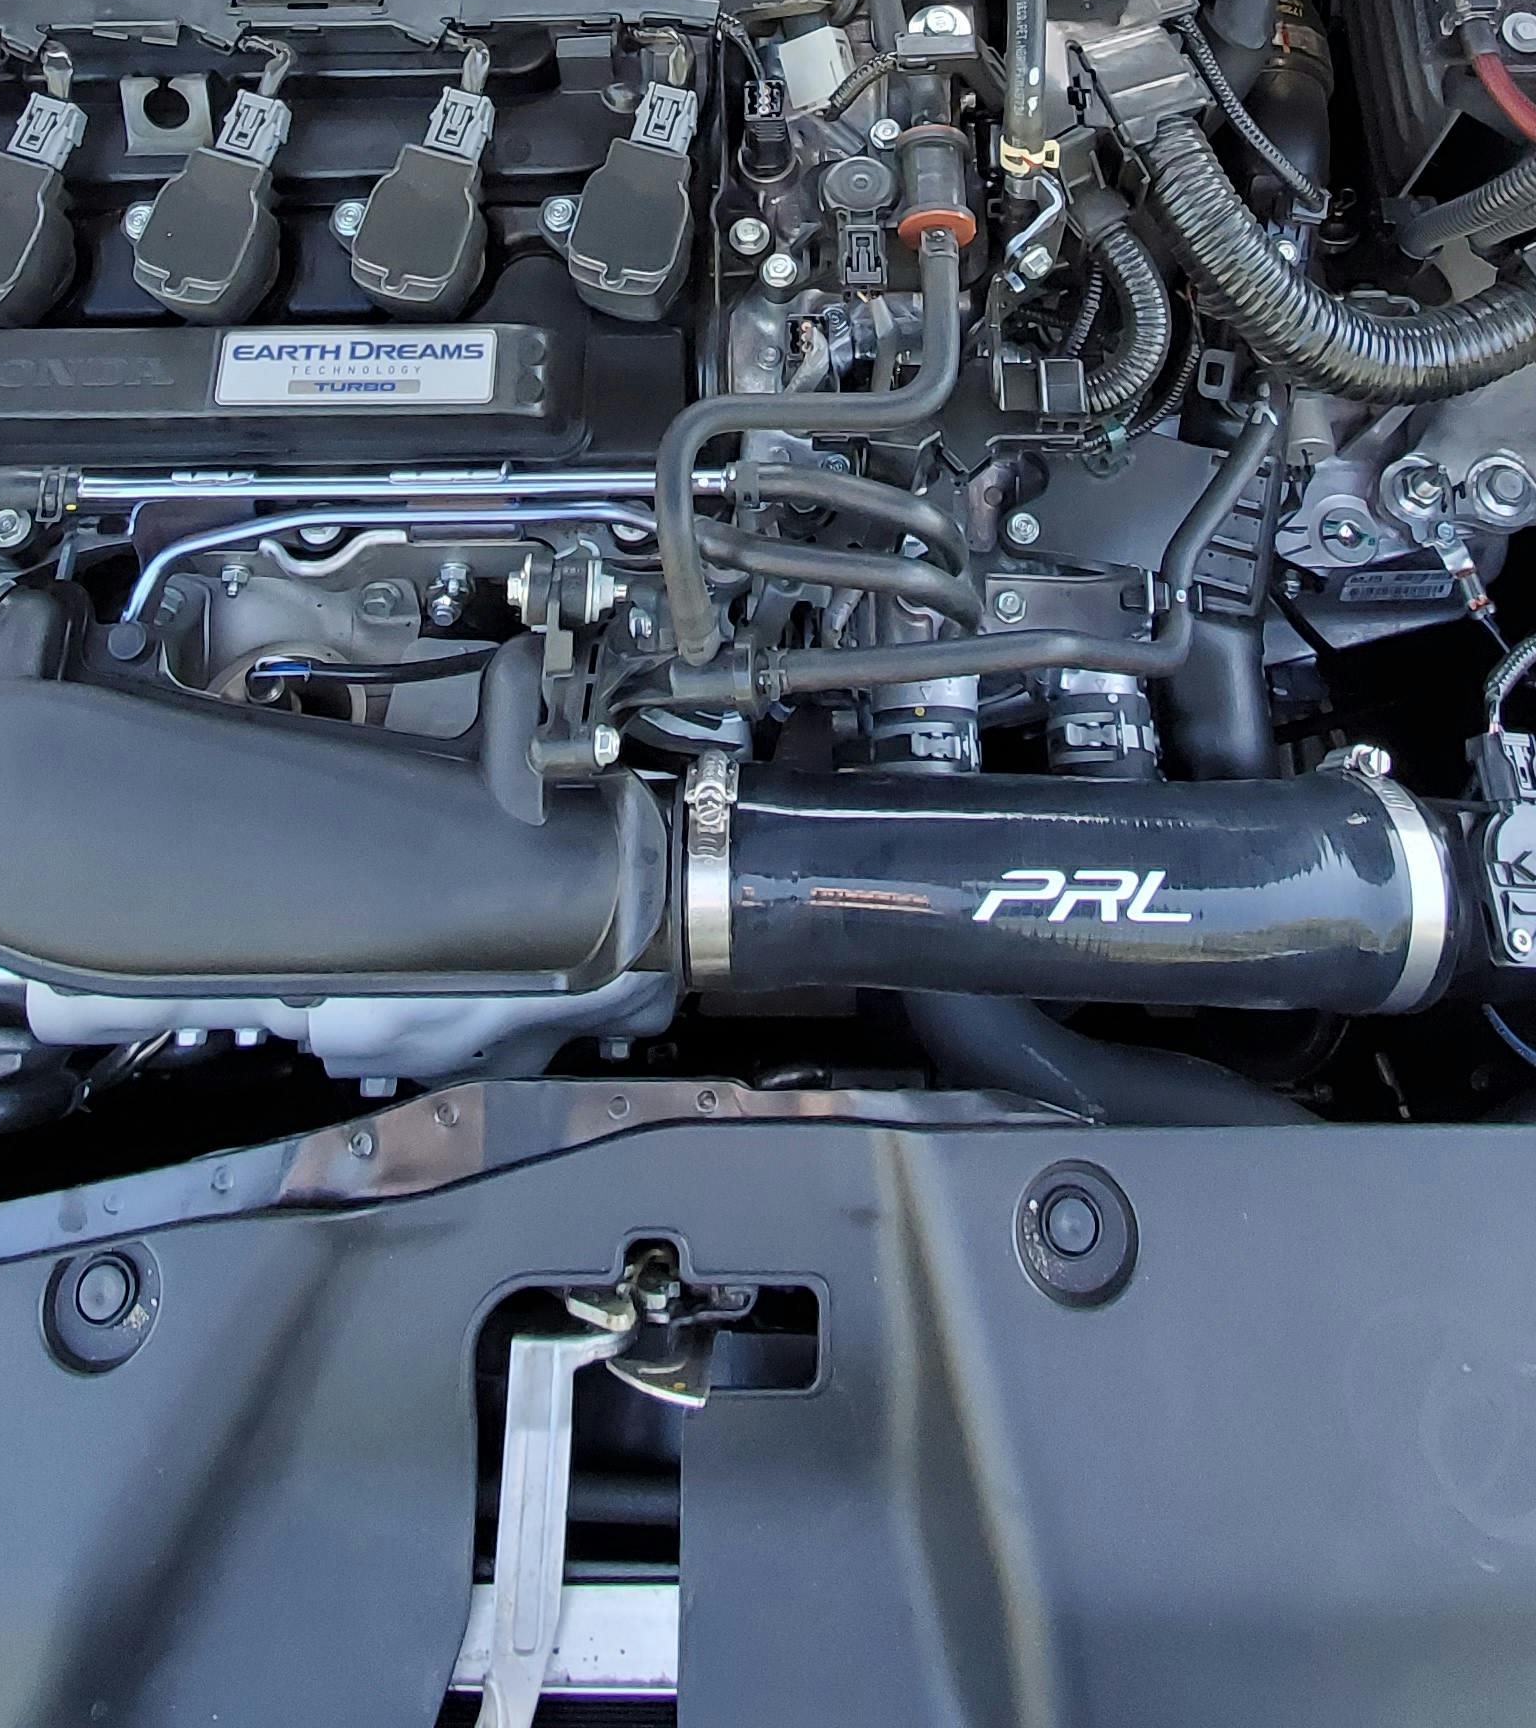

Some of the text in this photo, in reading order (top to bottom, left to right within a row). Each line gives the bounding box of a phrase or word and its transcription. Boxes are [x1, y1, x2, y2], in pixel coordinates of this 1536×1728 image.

[233, 341, 484, 361] EARTH DREAMS
[291, 365, 422, 375] TECHNOLOGY
[314, 382, 396, 392] TURBO
[972, 869, 1193, 922] PRL
